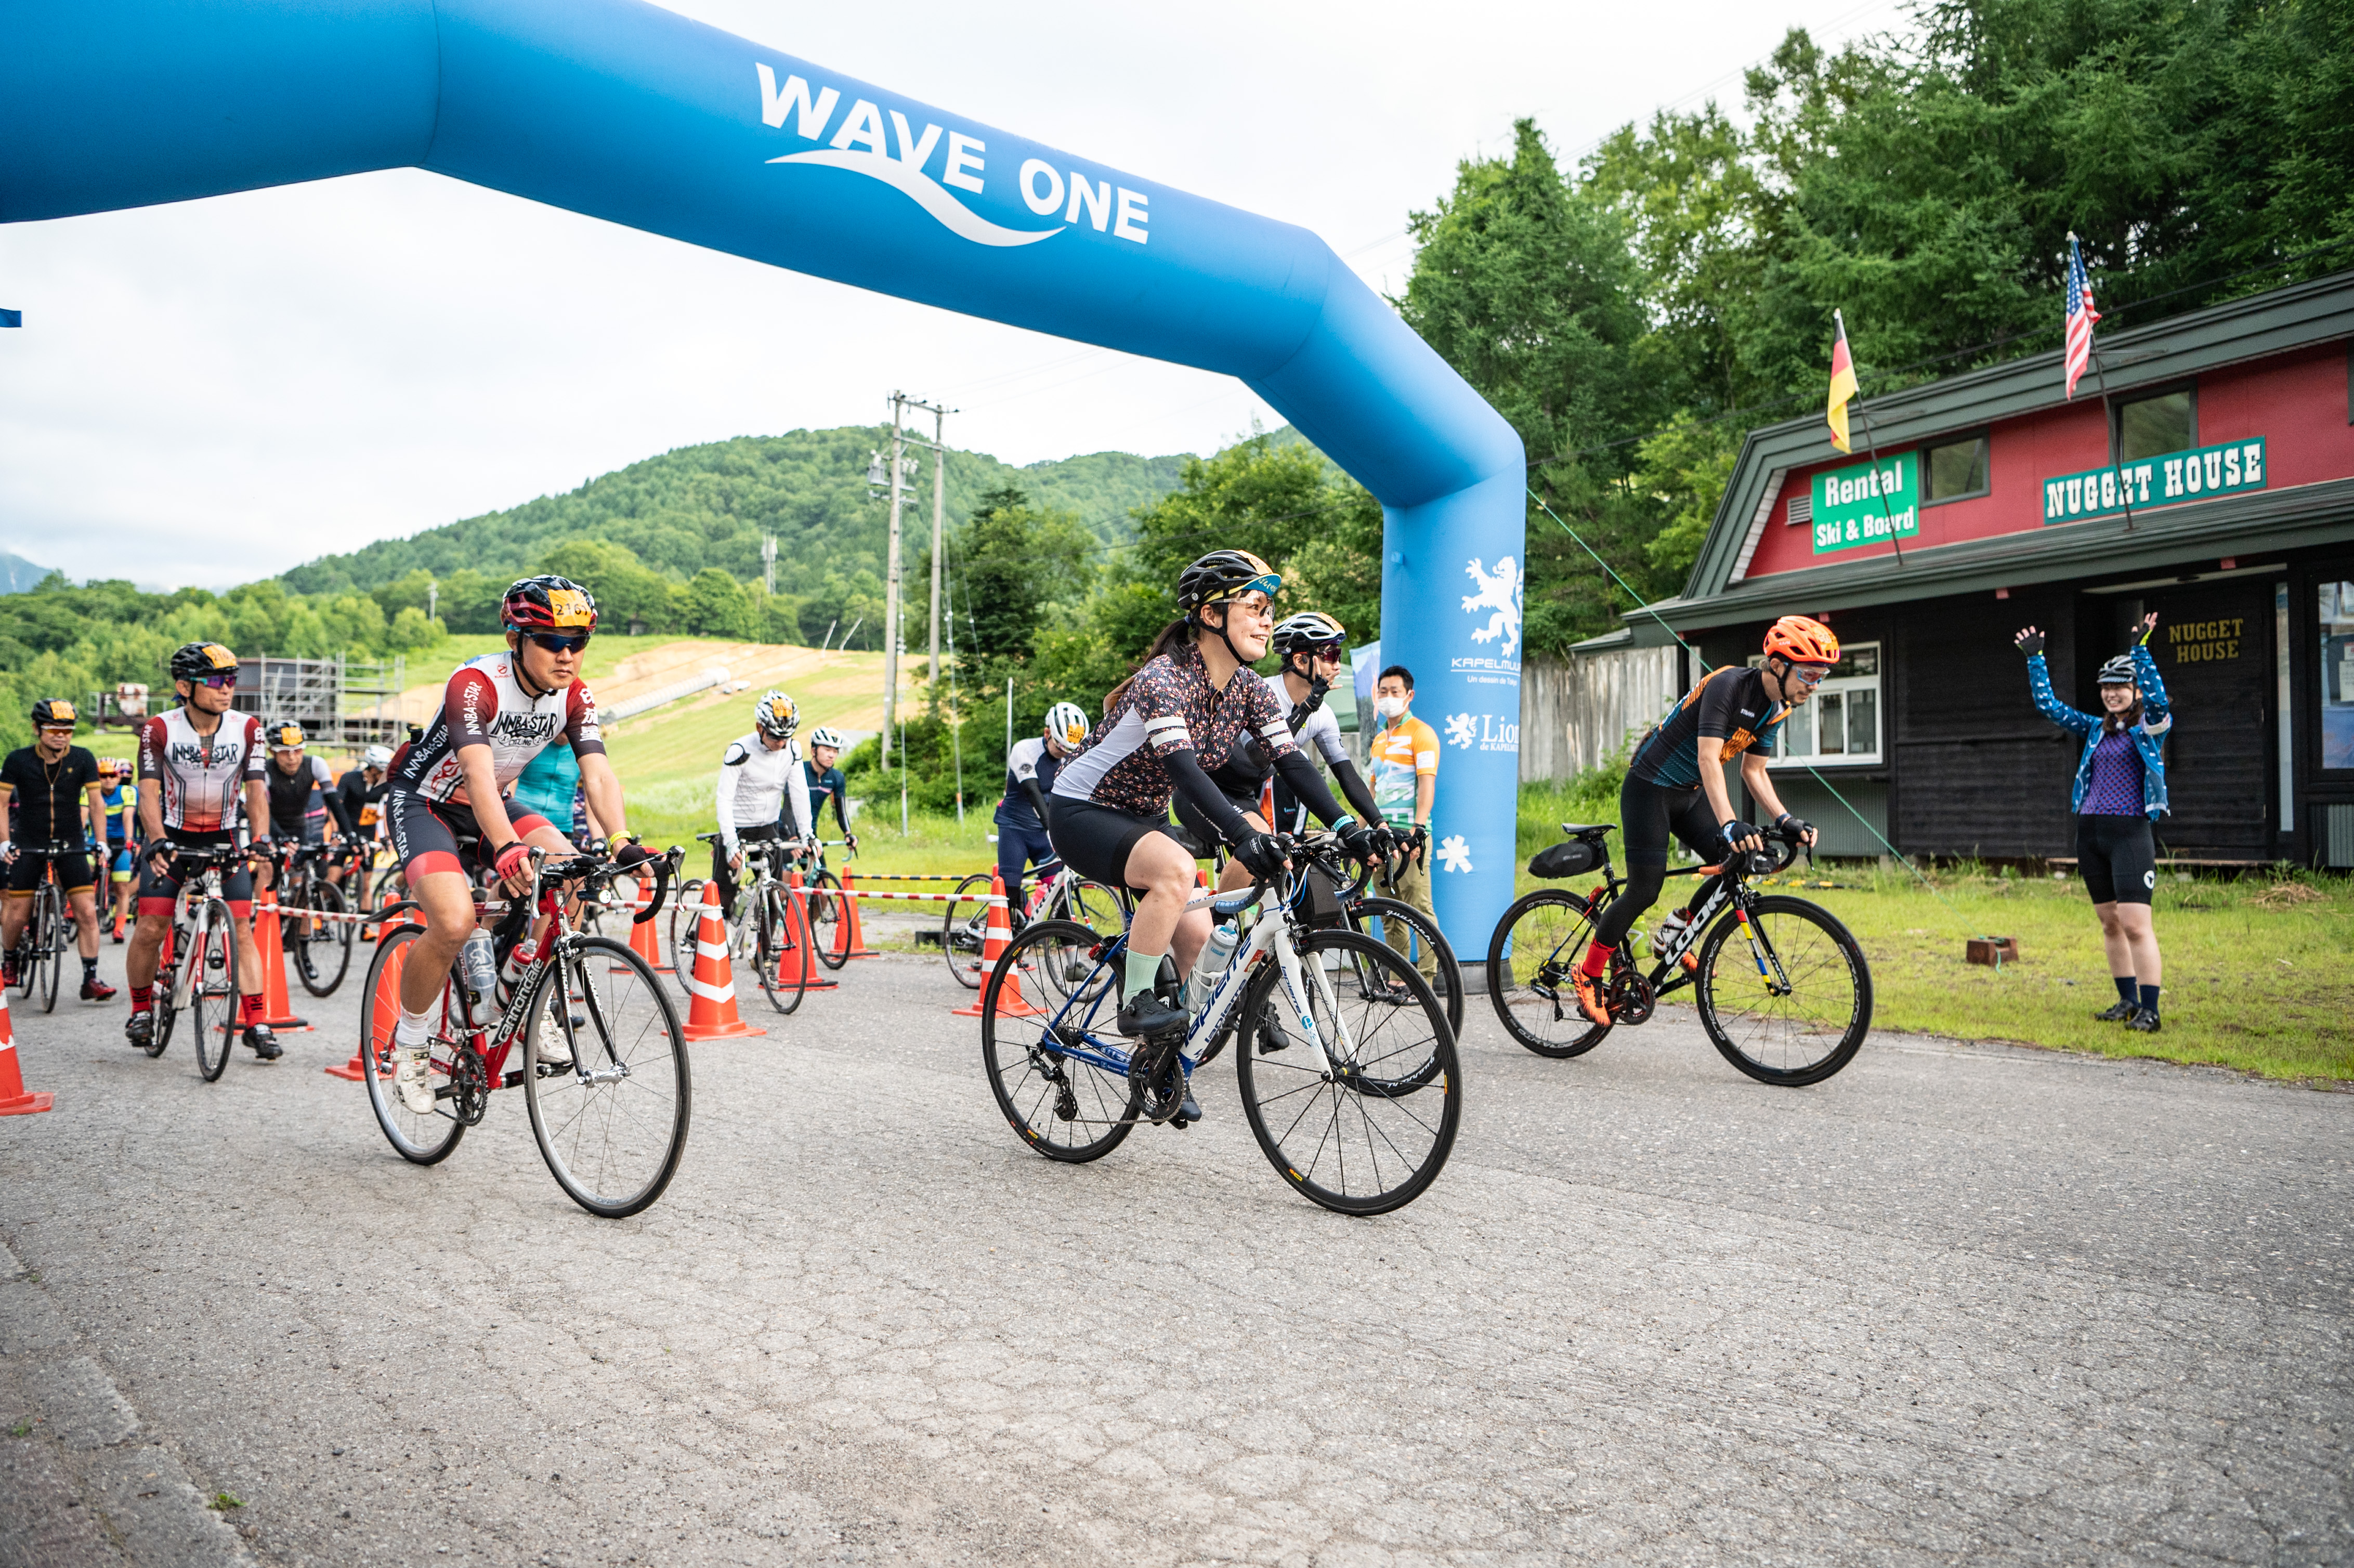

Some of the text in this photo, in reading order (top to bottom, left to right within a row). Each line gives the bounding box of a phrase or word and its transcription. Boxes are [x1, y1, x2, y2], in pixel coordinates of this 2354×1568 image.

[755, 62, 1149, 245] WAVE ONE
[1825, 460, 1903, 507] Rental
[2047, 443, 2262, 518] NUGGET HOUSE
[1816, 505, 1914, 547] Ski & Board
[2168, 618, 2243, 644] NUGGET
[2177, 639, 2239, 664] HOUSE
[464, 681, 482, 701] STAR
[490, 711, 557, 737] INNBA STAR
[213, 743, 238, 761] STAR
[403, 747, 434, 780] INNBA
[1480, 742, 1489, 750] de
[396, 832, 410, 862] STAR
[1665, 881, 1727, 965] LOOK
[498, 957, 544, 1042] cannondale
[1204, 978, 1247, 1043] lapierre
[1281, 966, 1302, 1014] lapierre
[1703, 939, 1726, 1040] CAMPAGNOLO
